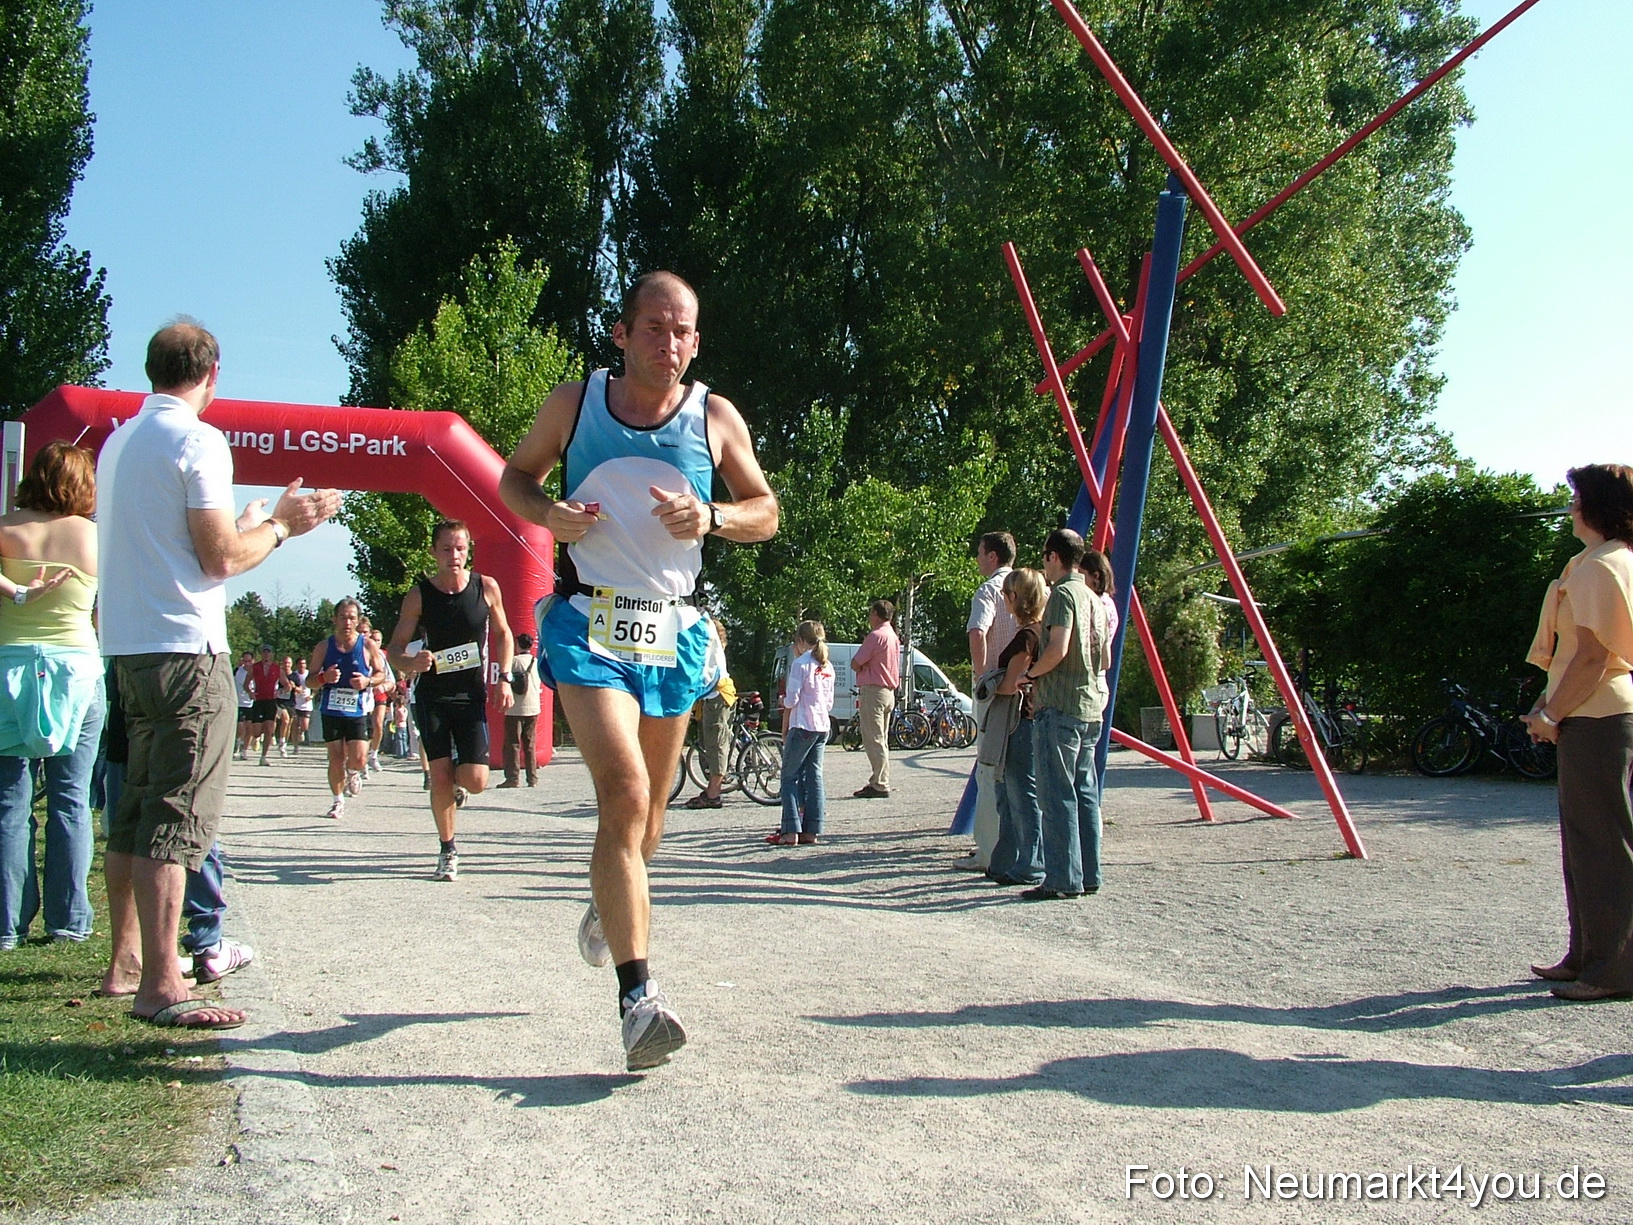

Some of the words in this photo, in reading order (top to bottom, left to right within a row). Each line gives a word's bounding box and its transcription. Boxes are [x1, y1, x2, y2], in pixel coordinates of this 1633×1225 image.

[226, 430, 275, 455] ung
[283, 429, 407, 456] LGS-Park
[594, 613, 605, 626] A
[614, 620, 657, 644] 505
[446, 649, 469, 665] 989
[336, 696, 356, 706] 2152
